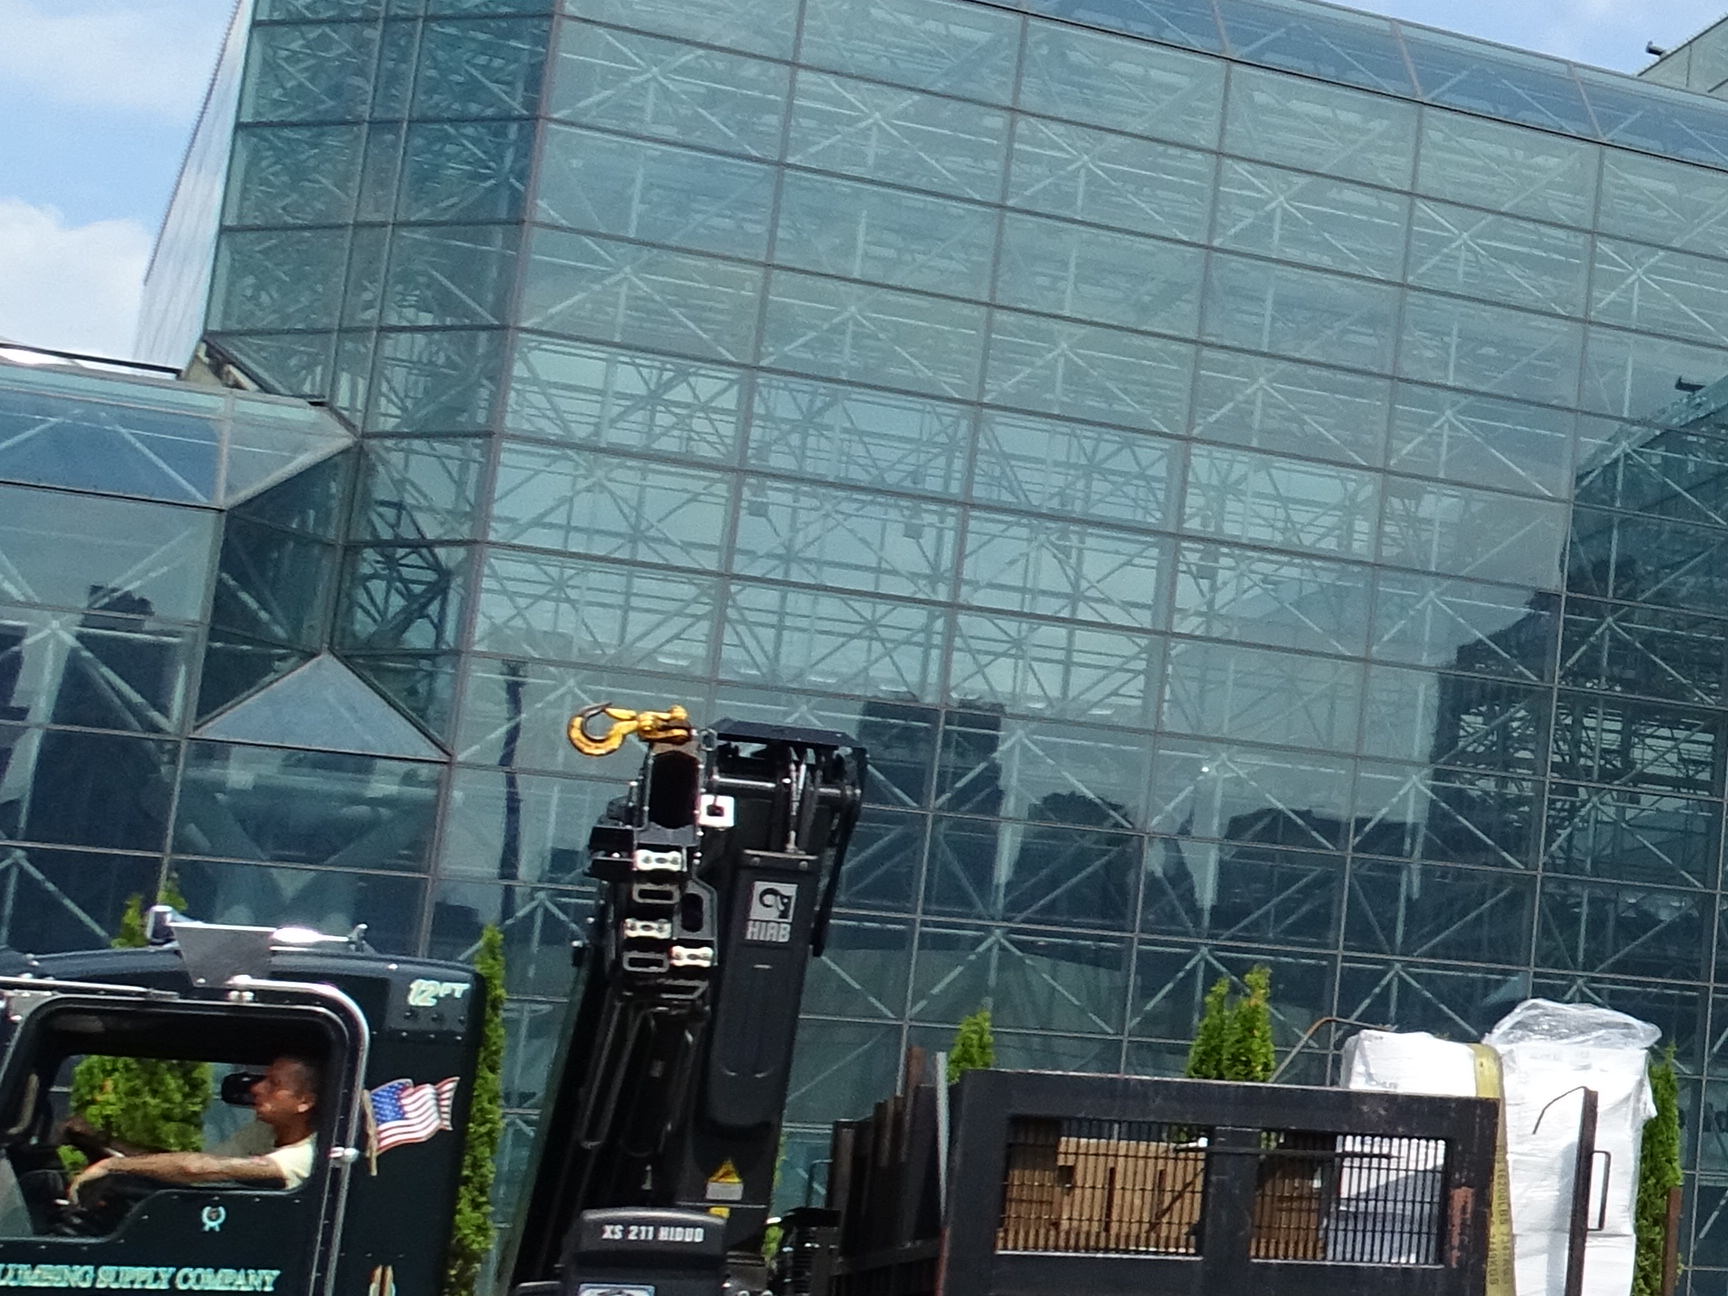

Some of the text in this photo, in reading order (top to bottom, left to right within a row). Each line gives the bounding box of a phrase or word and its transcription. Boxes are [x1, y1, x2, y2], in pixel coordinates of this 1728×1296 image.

[745, 919, 791, 942] HIAB
[602, 1224, 624, 1240] XS
[628, 1225, 654, 1241] 211
[95, 1265, 177, 1290] SUPPLY
[175, 1267, 281, 1292] COMPANY
